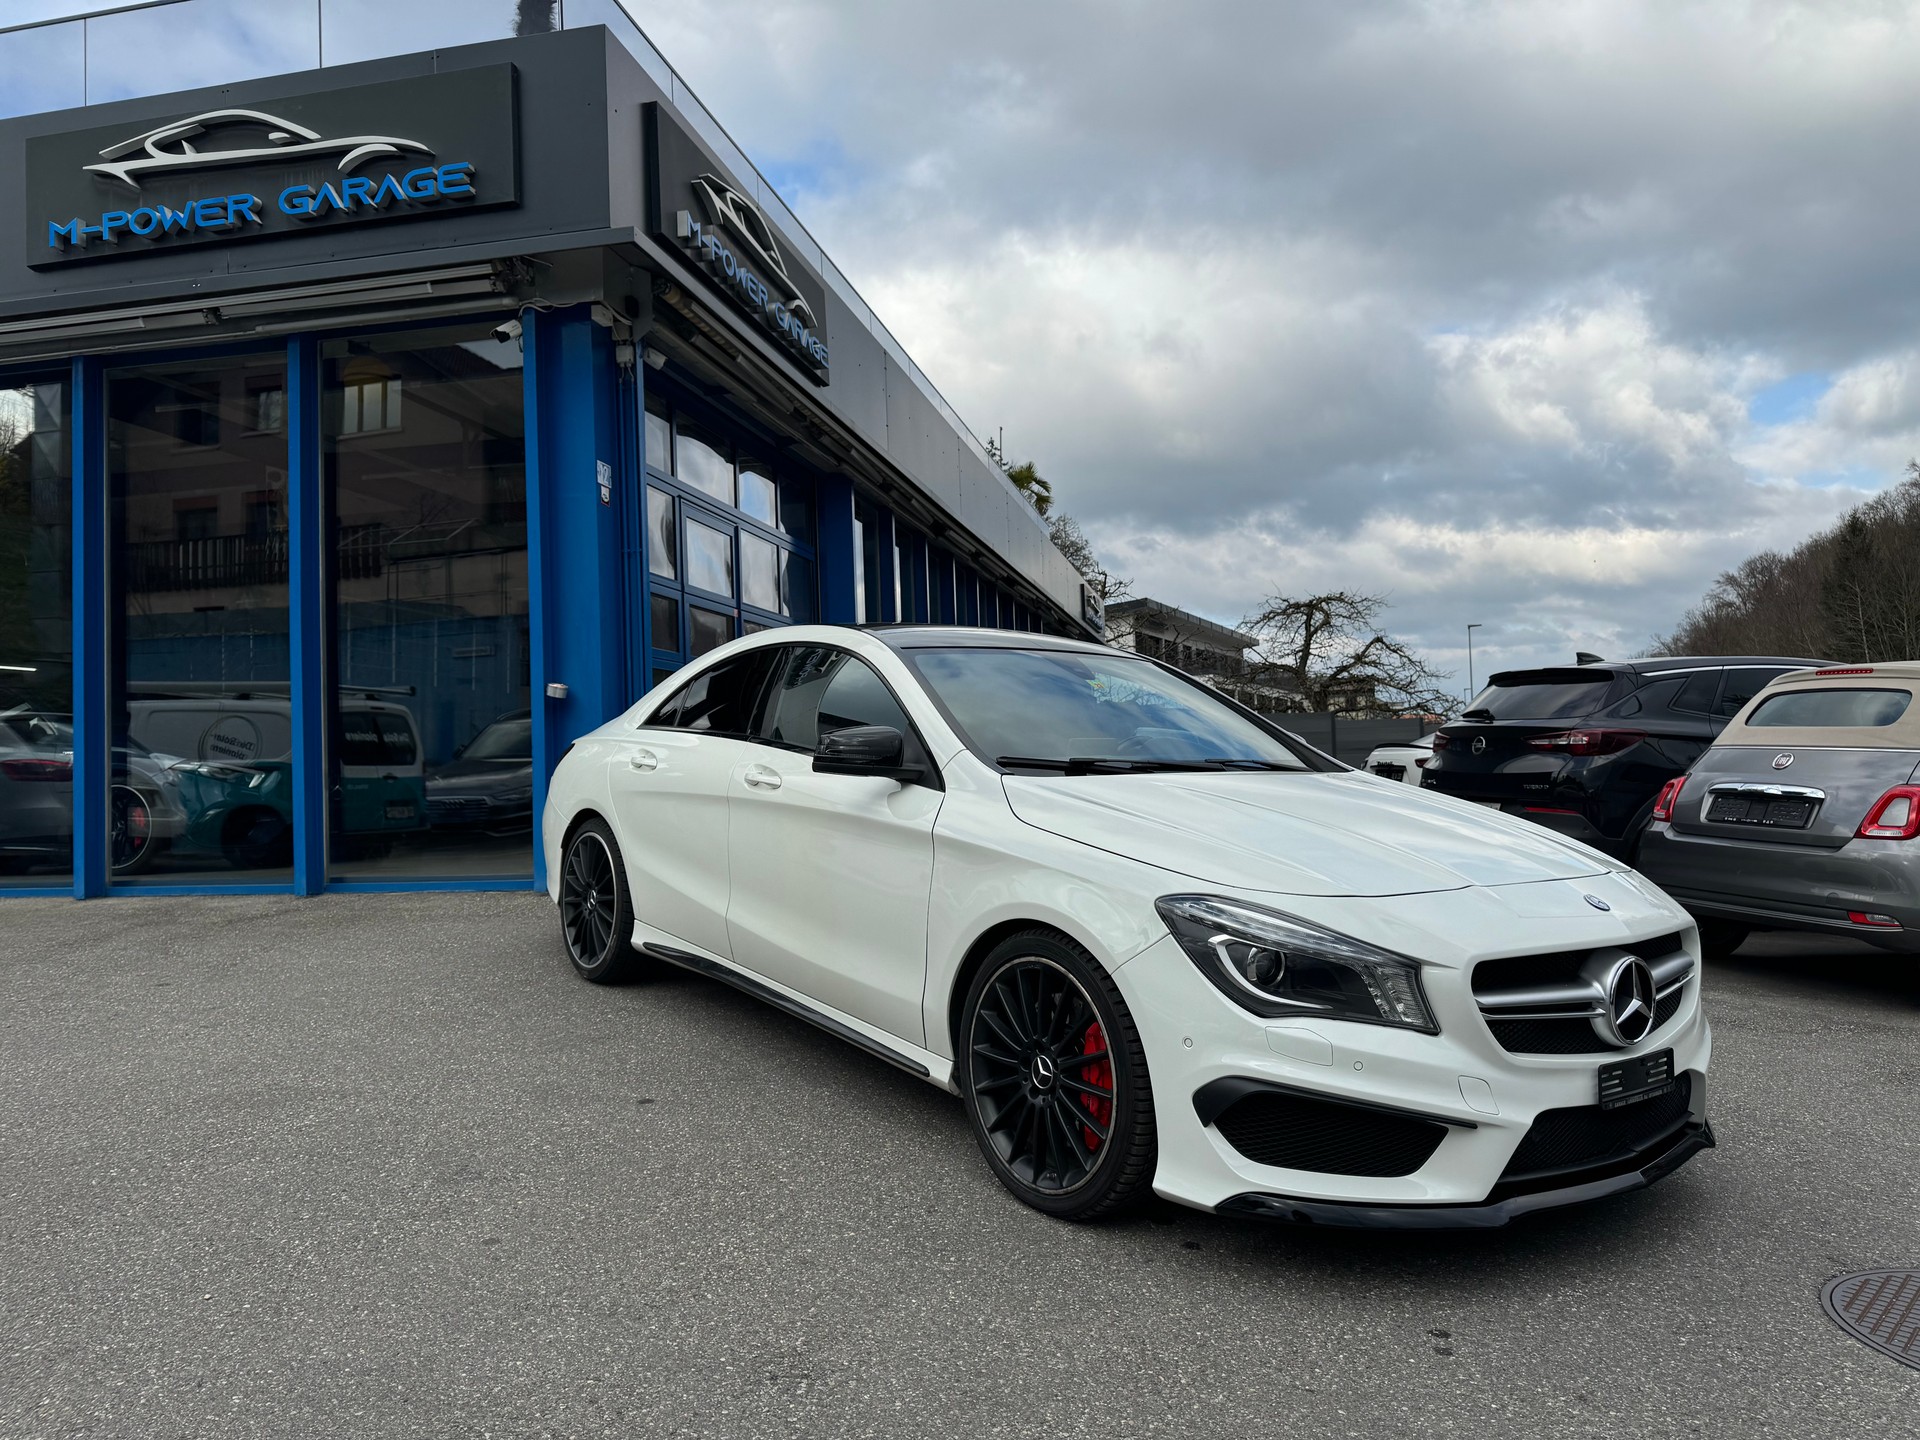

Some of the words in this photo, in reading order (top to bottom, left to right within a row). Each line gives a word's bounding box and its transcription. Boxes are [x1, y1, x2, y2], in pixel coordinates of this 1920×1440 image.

[48, 192, 257, 249] M-POWER
[277, 161, 474, 216] GARAGE
[686, 210, 768, 313] M-POWER
[773, 303, 830, 369] GARAGE
[1776, 757, 1790, 765] FIAT
